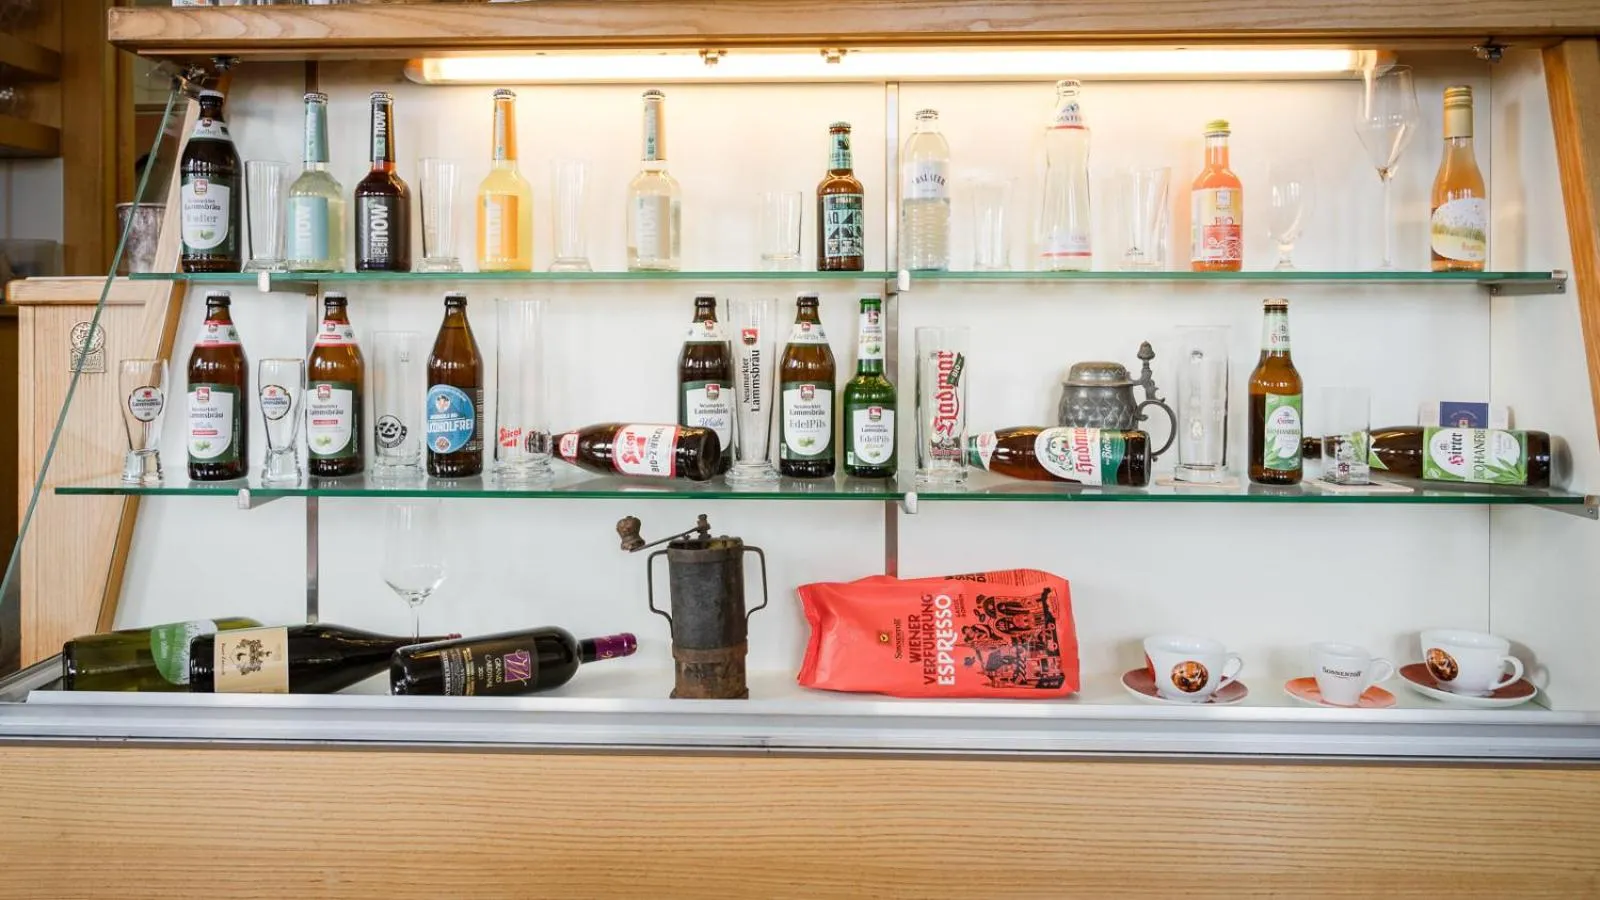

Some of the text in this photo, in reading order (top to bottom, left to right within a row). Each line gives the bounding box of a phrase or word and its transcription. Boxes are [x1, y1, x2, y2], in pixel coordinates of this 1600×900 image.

[370, 204, 388, 241] now
[750, 349, 761, 412] Lammsbräu
[933, 351, 957, 436] Hadmar
[789, 417, 826, 428] EdelPils
[1448, 431, 1465, 466] Hirter
[908, 614, 922, 664] WIENER
[934, 594, 958, 686] ESPRESSO
